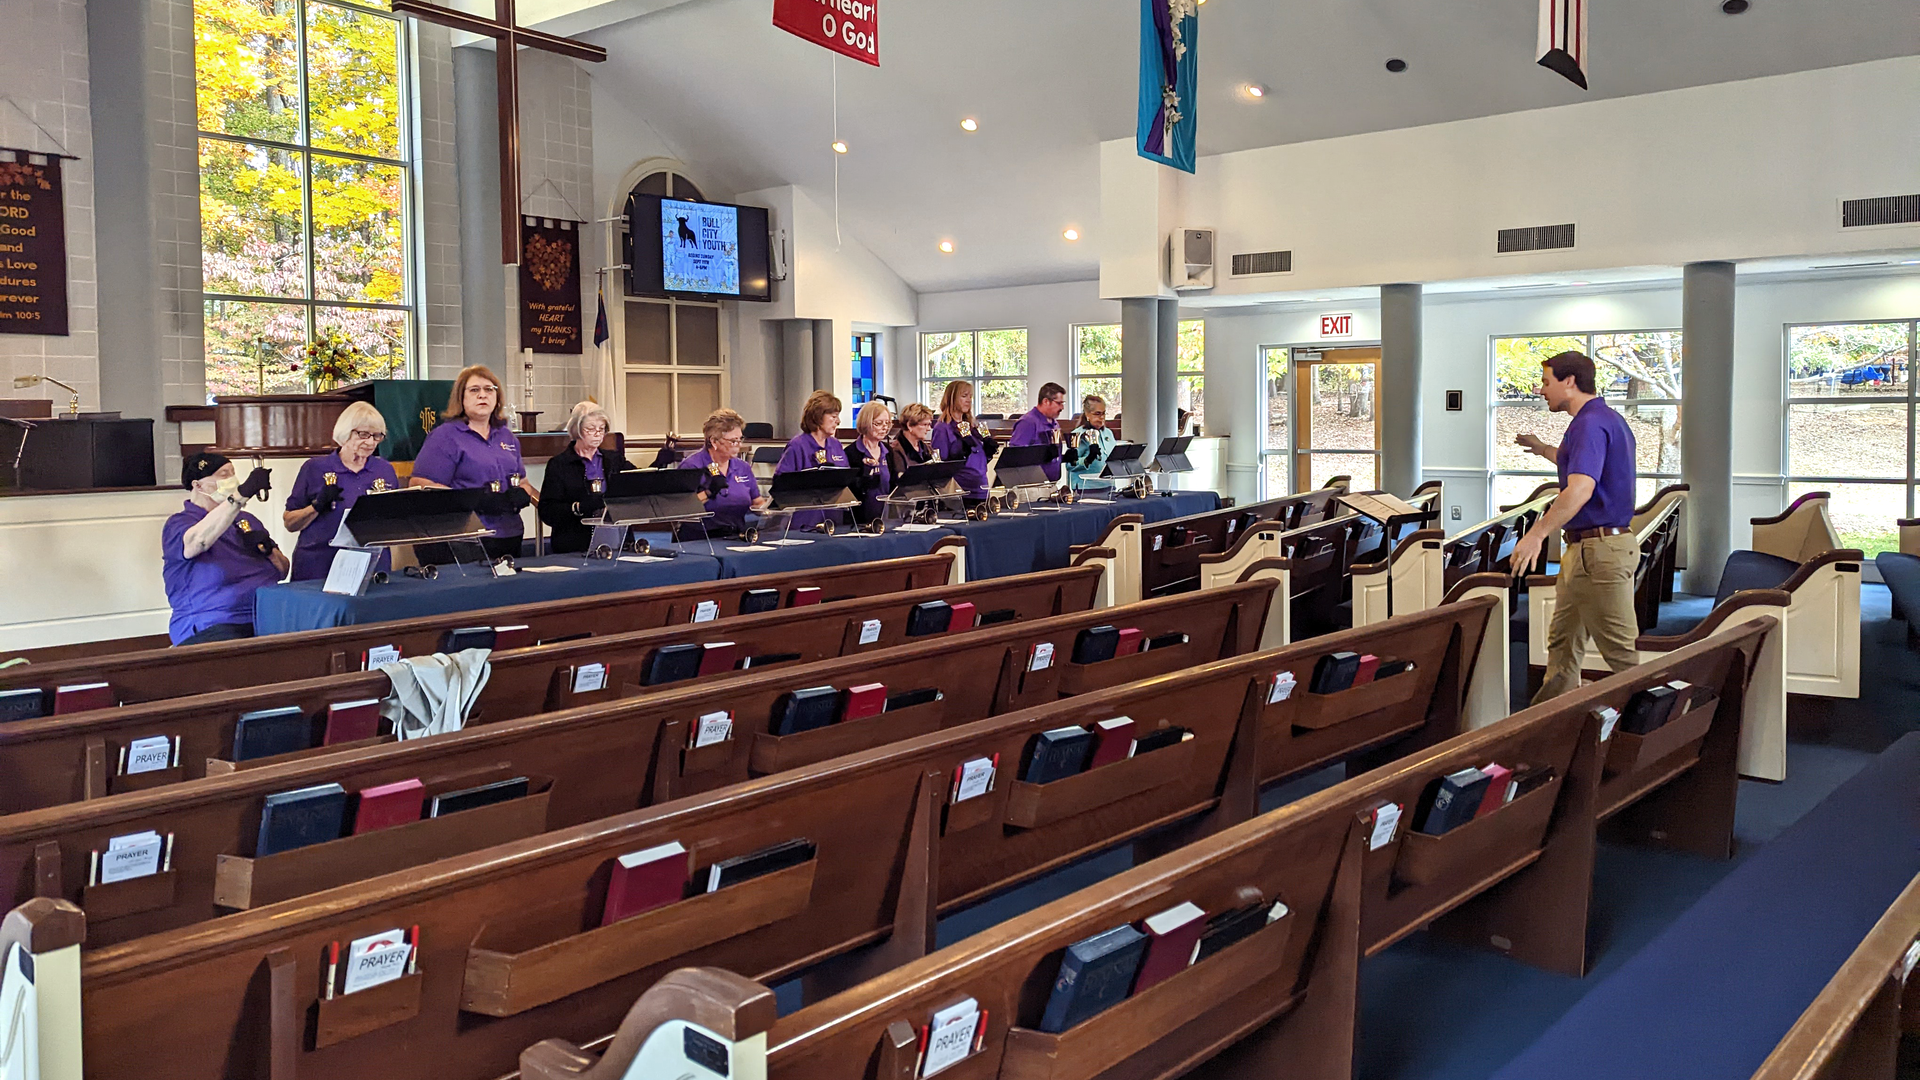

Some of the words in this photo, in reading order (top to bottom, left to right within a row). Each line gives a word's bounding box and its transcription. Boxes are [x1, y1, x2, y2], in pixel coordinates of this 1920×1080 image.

[823, 13, 837, 38] O
[842, 21, 876, 54] God
[11, 189, 31, 201] the
[702, 217, 720, 228] BULL
[0, 223, 36, 237] Good
[702, 228, 718, 239] CITY
[702, 239, 726, 251] YOUTH
[7, 258, 38, 270] Love
[529, 302, 546, 310] With
[547, 304, 576, 312] grateful
[15, 311, 41, 320] 100:5
[538, 313, 565, 322] HEART
[530, 327, 542, 335] my
[543, 325, 572, 334] THANKS
[1322, 316, 1351, 334] EXIT
[548, 336, 567, 346] bring
[372, 654, 394, 665] PRAYER
[704, 723, 728, 735] PRAYER
[135, 751, 167, 764] PRAYER
[967, 771, 985, 782] PRAYER
[116, 849, 149, 861] PRAYER
[359, 950, 405, 970] PRAYER
[935, 1025, 972, 1053] PRAYER
